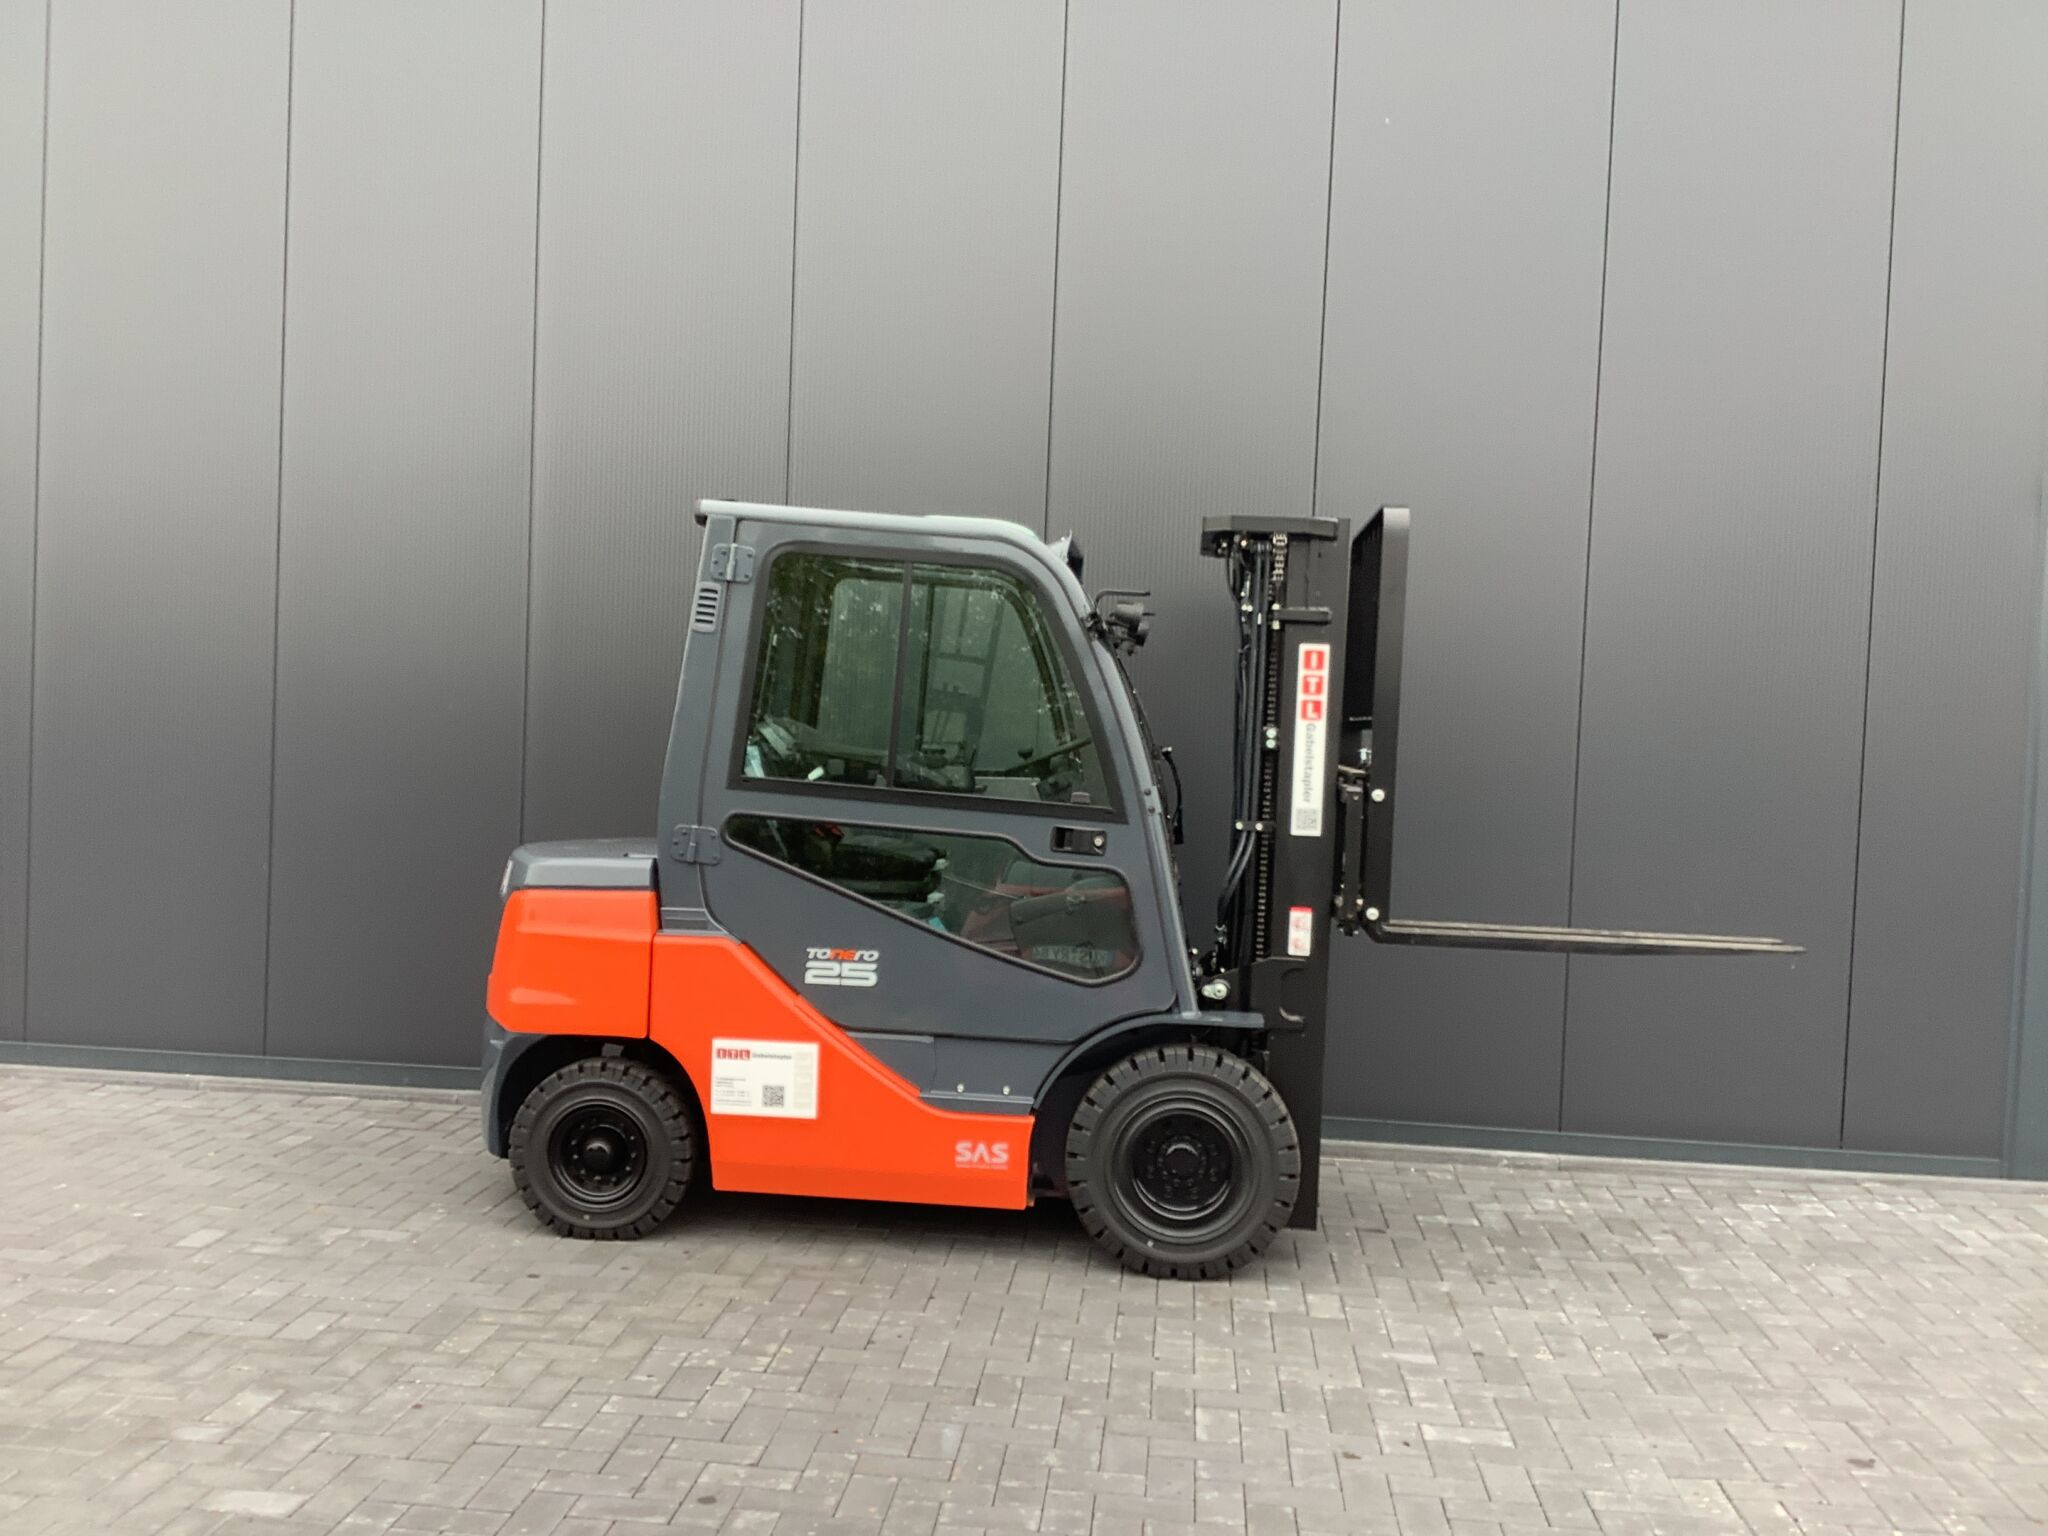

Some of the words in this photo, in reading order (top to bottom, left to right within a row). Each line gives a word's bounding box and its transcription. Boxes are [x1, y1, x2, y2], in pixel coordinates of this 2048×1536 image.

[1303, 651, 1323, 719] ITL
[804, 961, 878, 987] 25
[955, 1141, 1008, 1164] SAS
